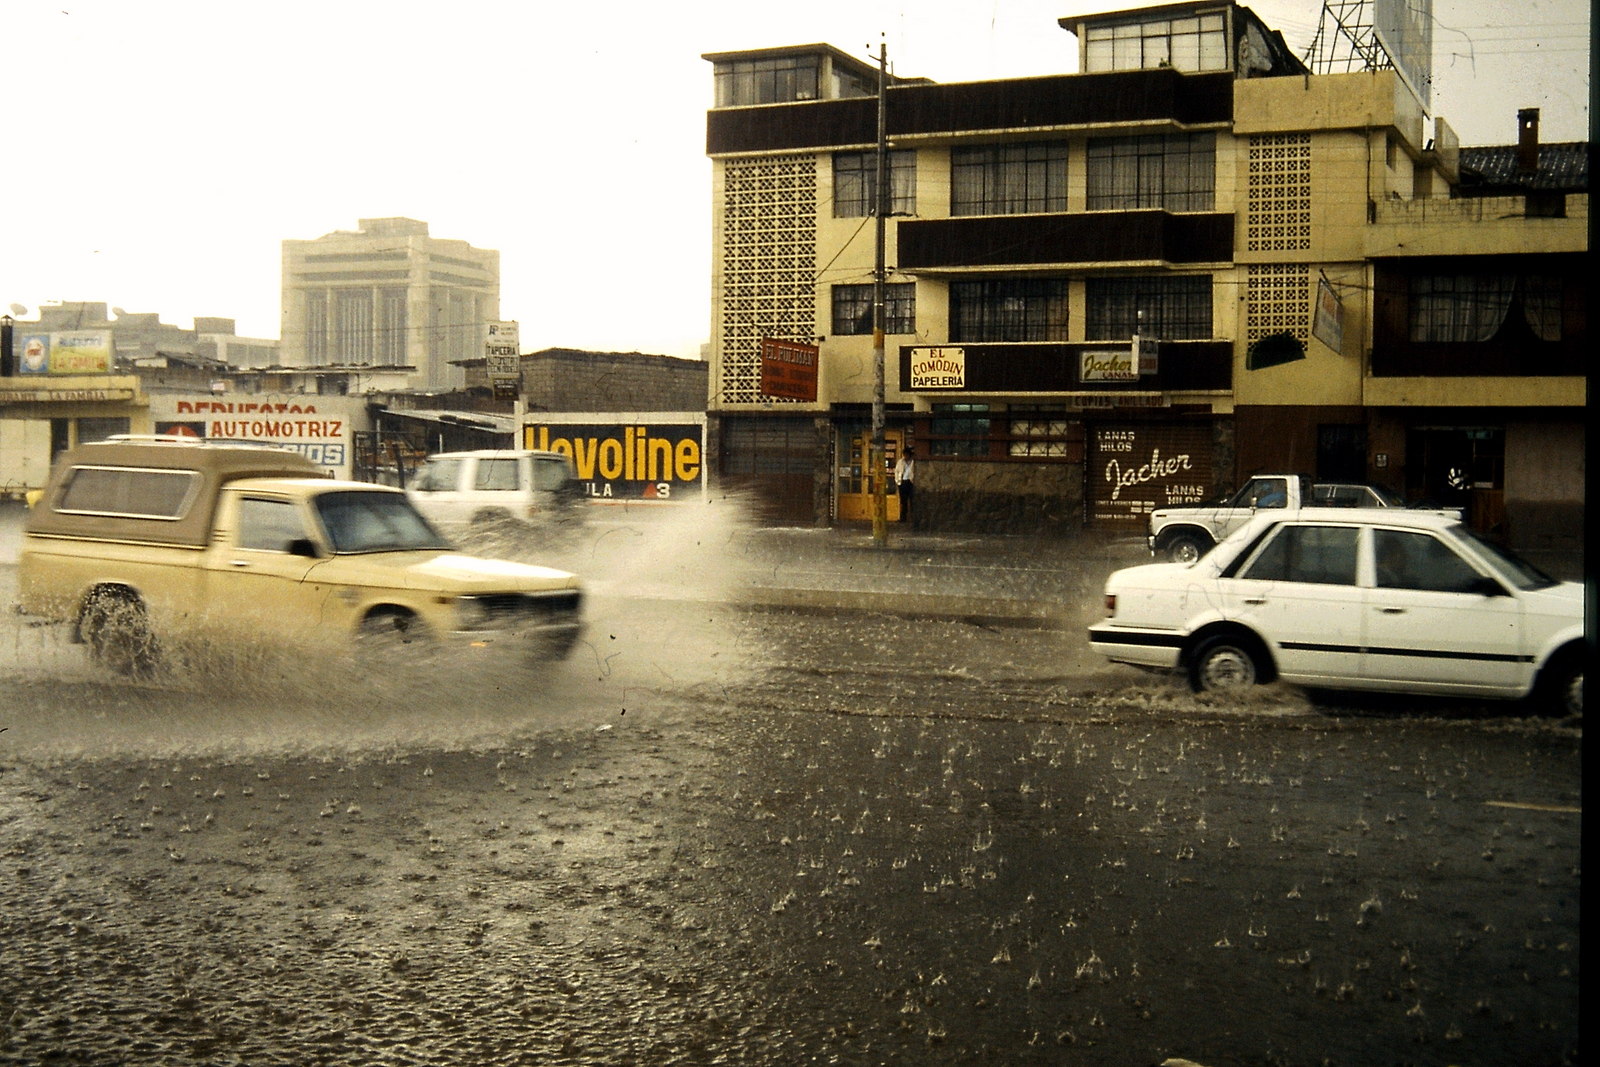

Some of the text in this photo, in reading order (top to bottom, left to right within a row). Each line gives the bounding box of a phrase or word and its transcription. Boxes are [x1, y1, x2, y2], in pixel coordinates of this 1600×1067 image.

[930, 349, 945, 358] EL
[912, 359, 963, 376] COMODIN
[912, 377, 963, 387] PAPELERIA
[211, 421, 342, 438] AUTOMOTRIZ
[1098, 431, 1135, 441] LANAS
[1100, 442, 1133, 452] HILOS
[1105, 448, 1192, 500] Jacher
[656, 483, 671, 498] 3
[1165, 484, 1204, 496] LANAS
